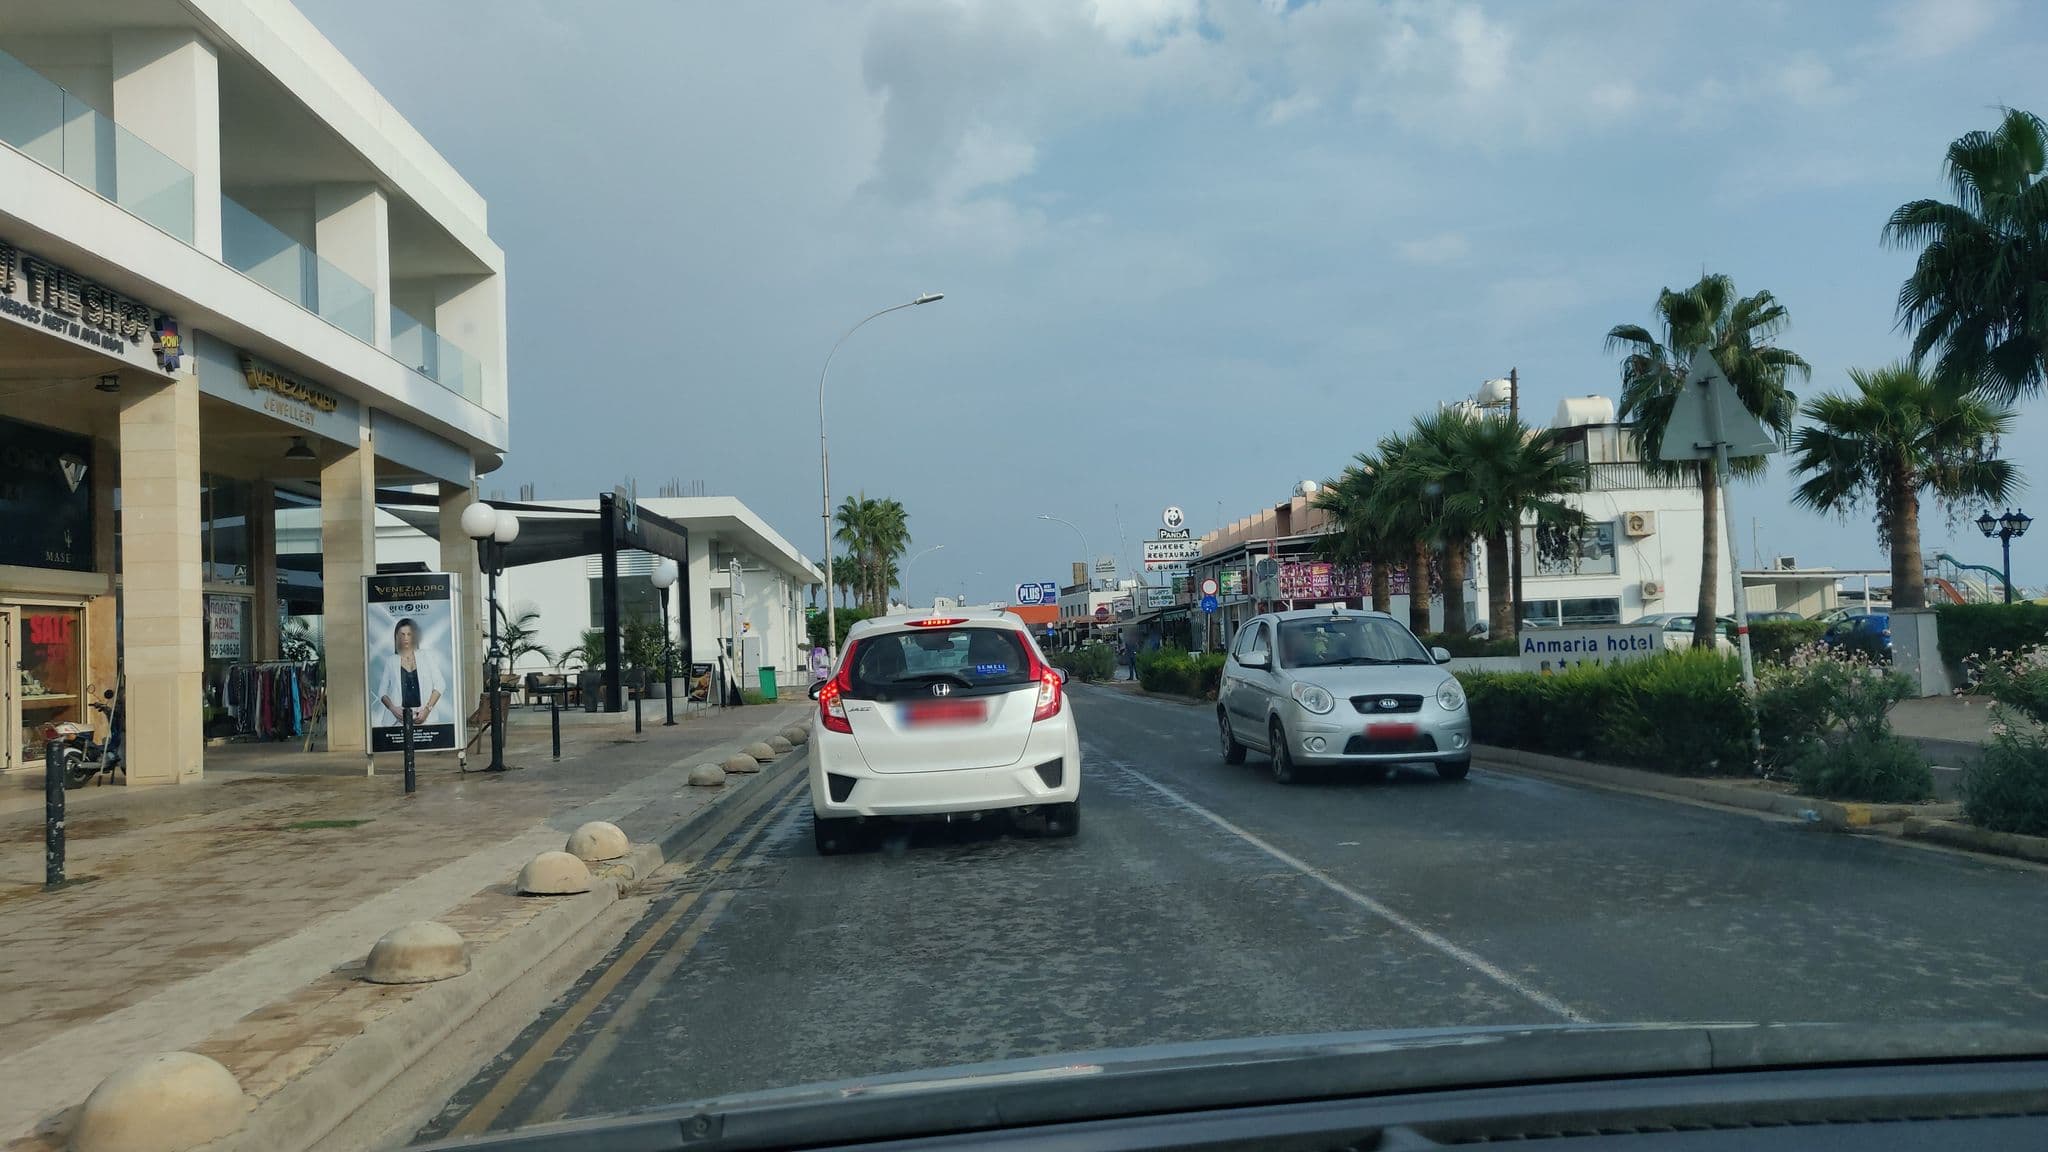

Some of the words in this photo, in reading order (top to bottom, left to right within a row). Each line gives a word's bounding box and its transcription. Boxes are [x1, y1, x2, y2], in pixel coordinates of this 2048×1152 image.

[24, 258, 83, 319] THE
[84, 283, 150, 346] SHOP
[41, 312, 69, 334] MEET
[160, 335, 179, 348] POW!
[253, 364, 313, 403] VENEZIA
[263, 397, 315, 426] JEWELLERY
[1160, 530, 1189, 539] PANDA
[1148, 543, 1185, 551] CHINESE
[1147, 551, 1201, 559] RESTAURANT
[378, 585, 421, 593] VENEZIA
[423, 584, 445, 592] ORO
[1020, 587, 1041, 601] PLUS
[1524, 635, 1598, 653] Anmaria
[1607, 633, 1653, 651] hotel
[1381, 700, 1397, 708] KIA
